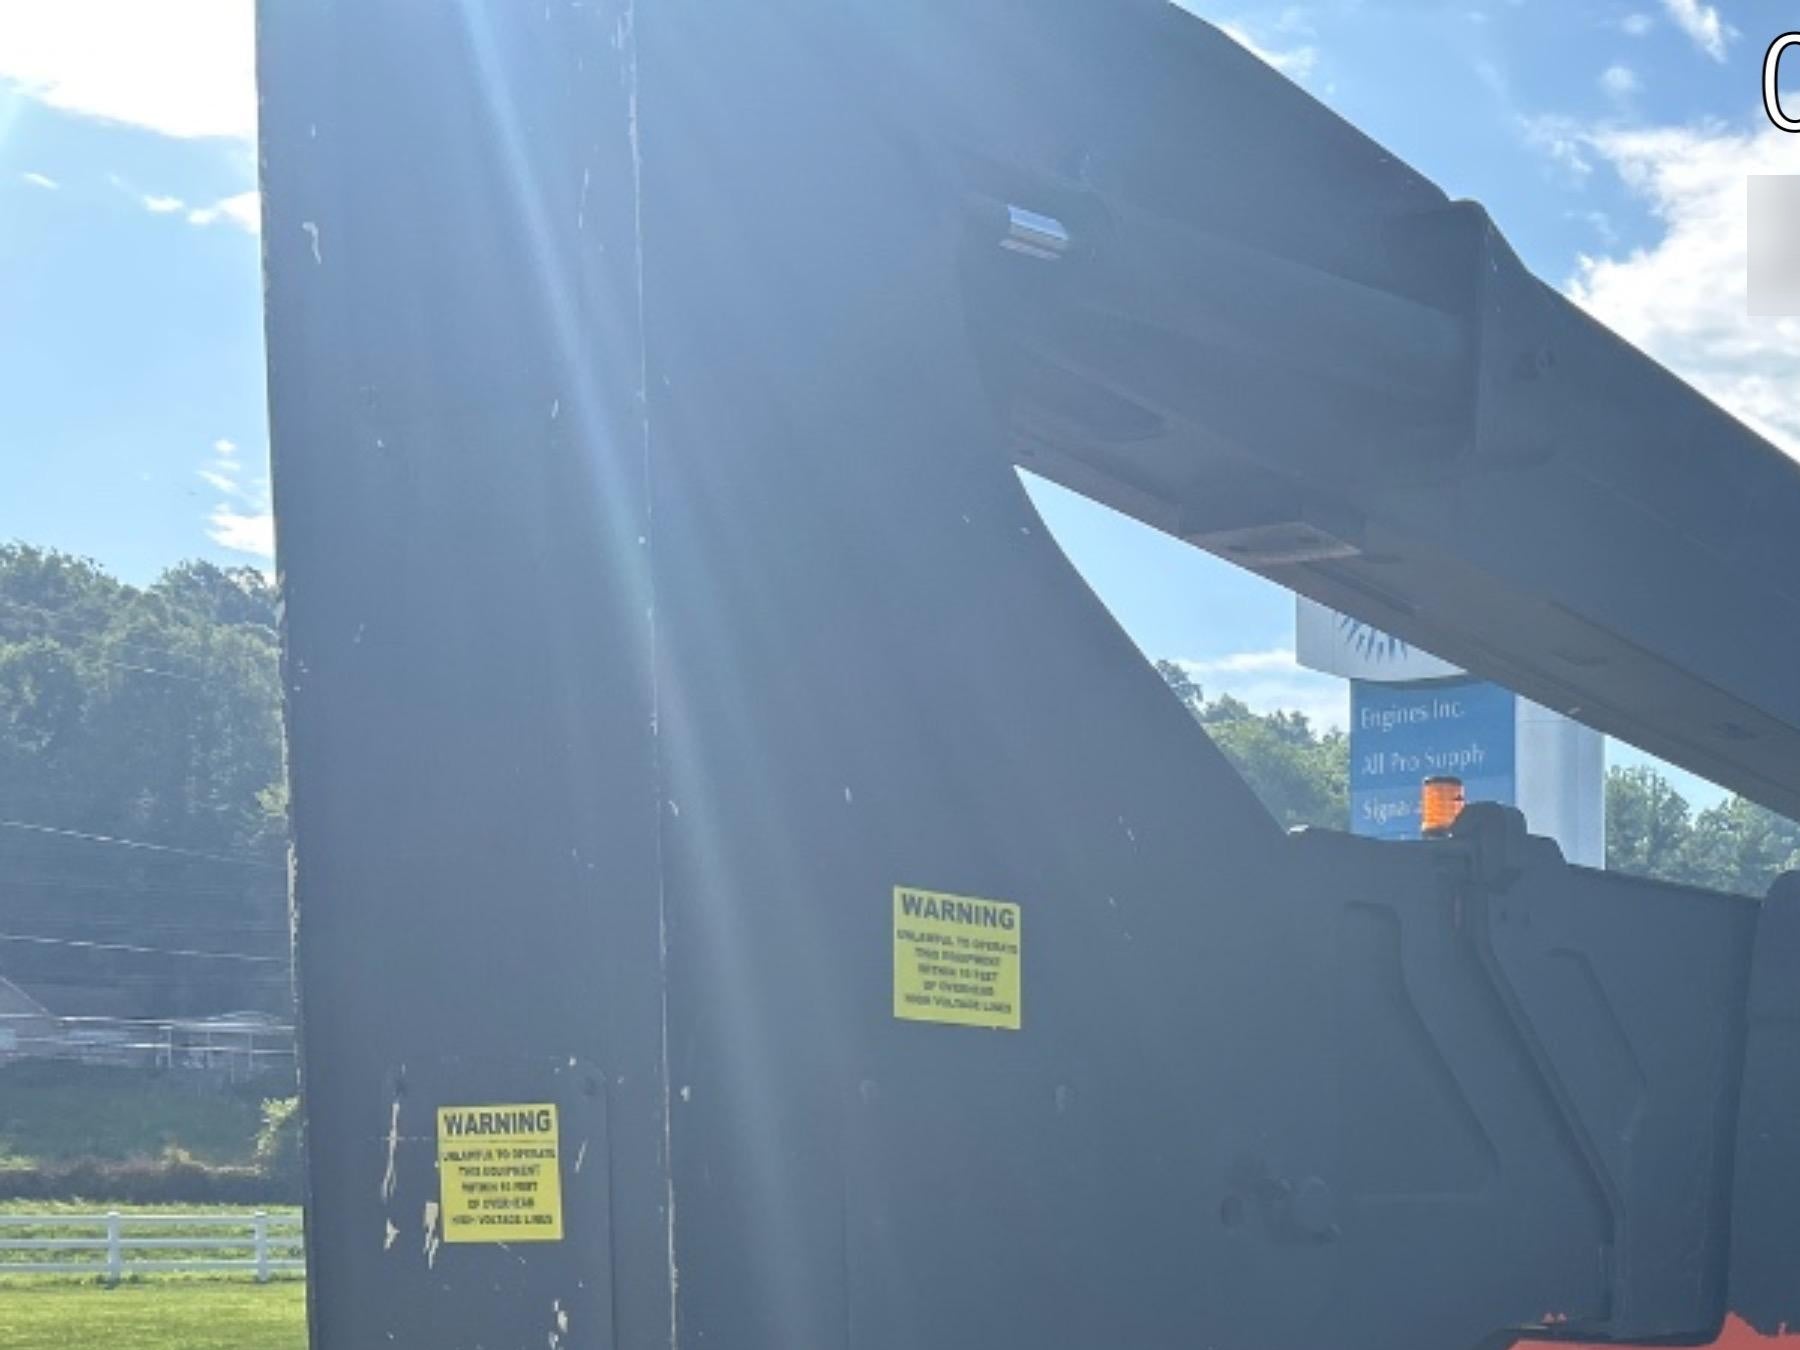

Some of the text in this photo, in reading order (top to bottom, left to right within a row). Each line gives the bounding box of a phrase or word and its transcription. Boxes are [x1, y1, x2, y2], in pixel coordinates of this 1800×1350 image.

[1361, 698, 1465, 733] Engines Inc.
[1361, 744, 1485, 776] All Pro Supply
[901, 893, 1015, 930] WARNING
[443, 1109, 552, 1136] WARNING
